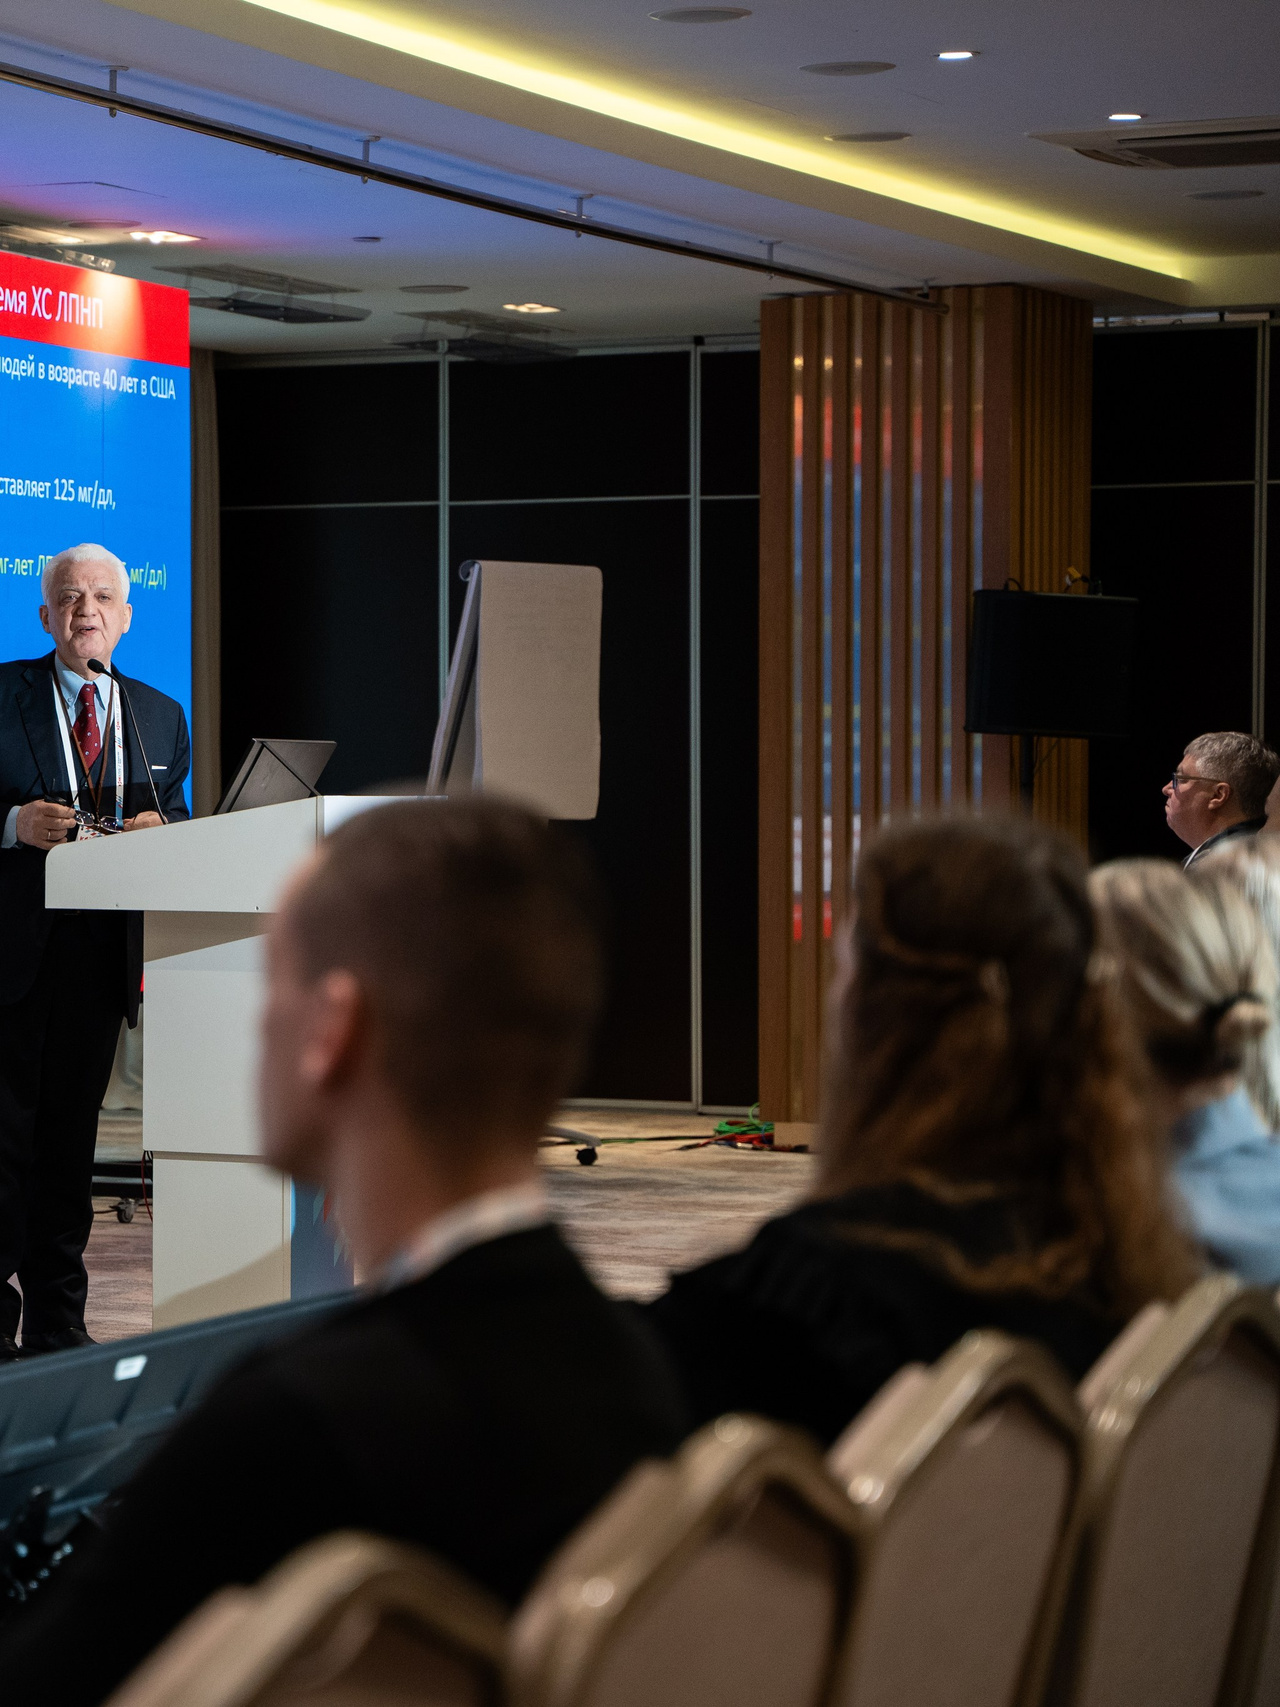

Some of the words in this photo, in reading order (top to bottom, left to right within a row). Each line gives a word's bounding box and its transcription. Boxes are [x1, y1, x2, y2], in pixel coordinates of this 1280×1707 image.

[31, 286, 53, 320] ХС
[55, 292, 104, 329] ЛПНП
[38, 363, 46, 378] в
[48, 367, 101, 389] возрасте
[102, 368, 118, 391] 40
[118, 378, 139, 394] лет
[141, 380, 148, 394] в
[149, 375, 177, 400] США
[53, 478, 75, 502] 125
[77, 480, 116, 510] мг/дл,
[130, 561, 167, 590] мг/дл)
